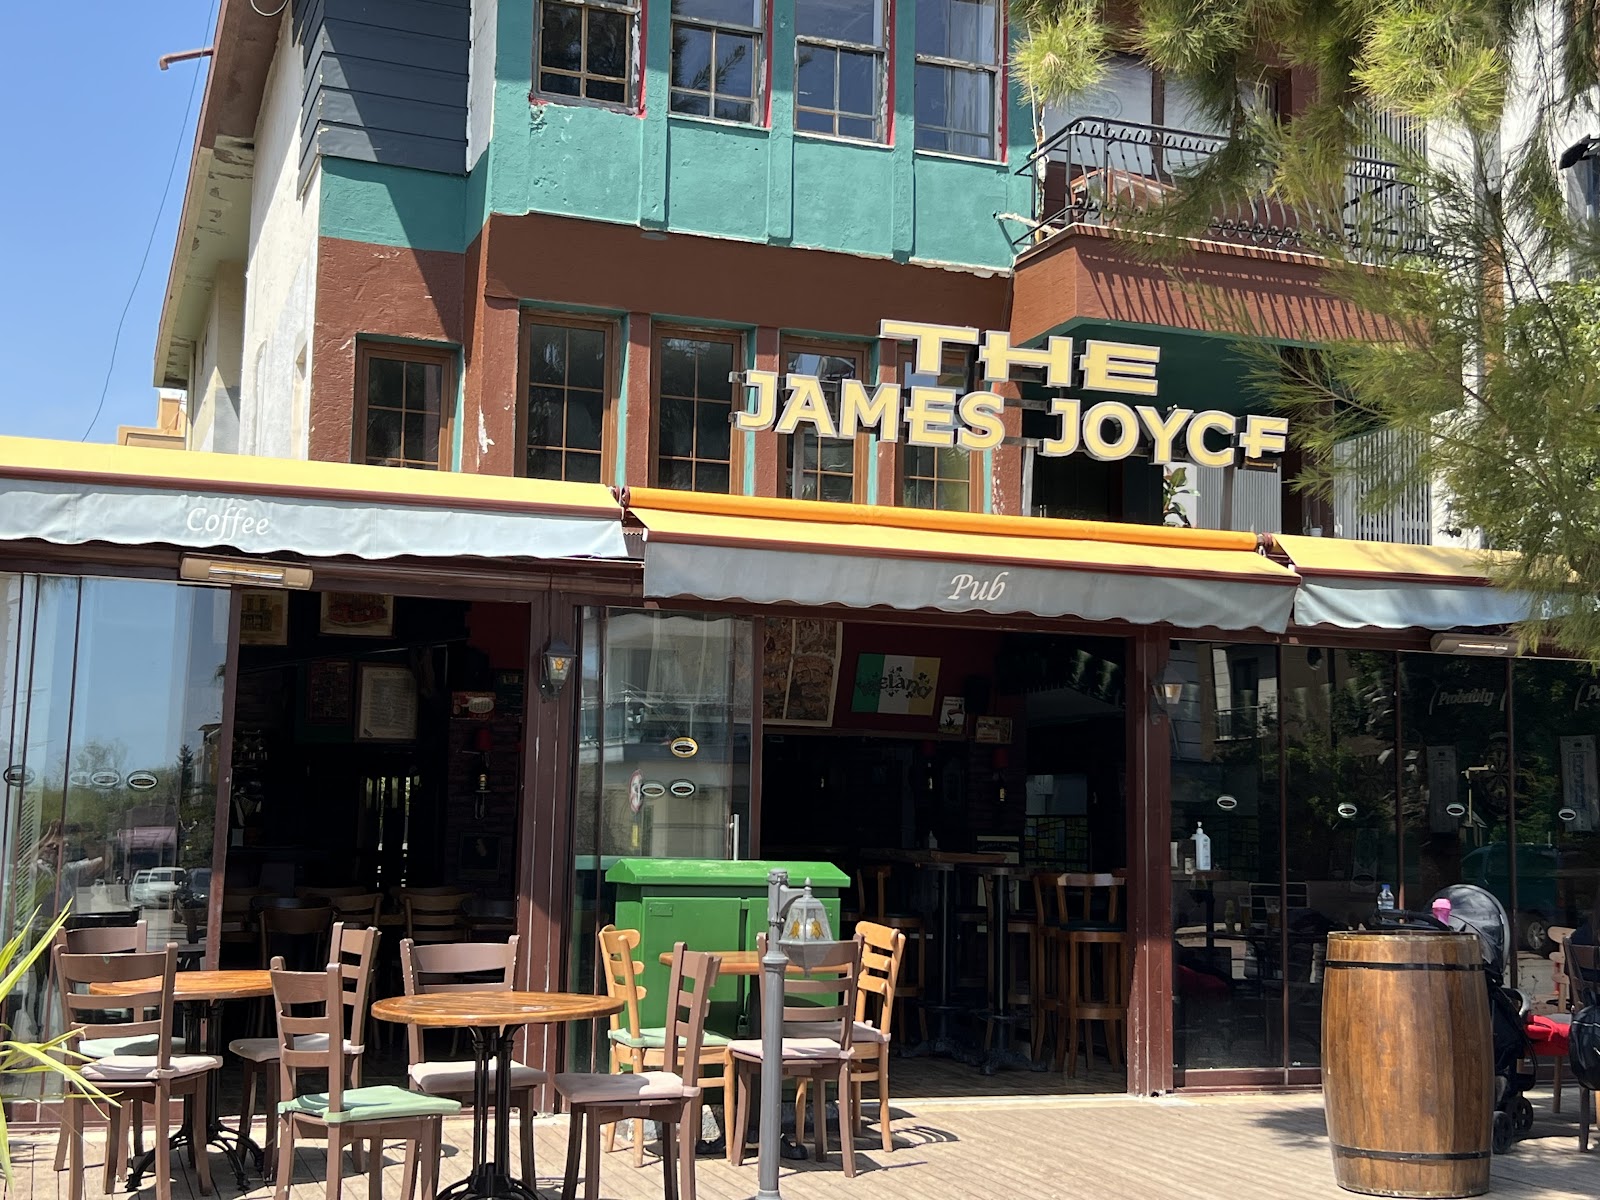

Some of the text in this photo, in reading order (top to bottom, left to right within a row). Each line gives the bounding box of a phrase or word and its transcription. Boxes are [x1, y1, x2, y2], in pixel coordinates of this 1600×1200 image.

[880, 318, 1161, 397] THE
[735, 369, 1005, 451] JAMES
[186, 507, 270, 541] Coffee
[947, 571, 1010, 601] Pub
